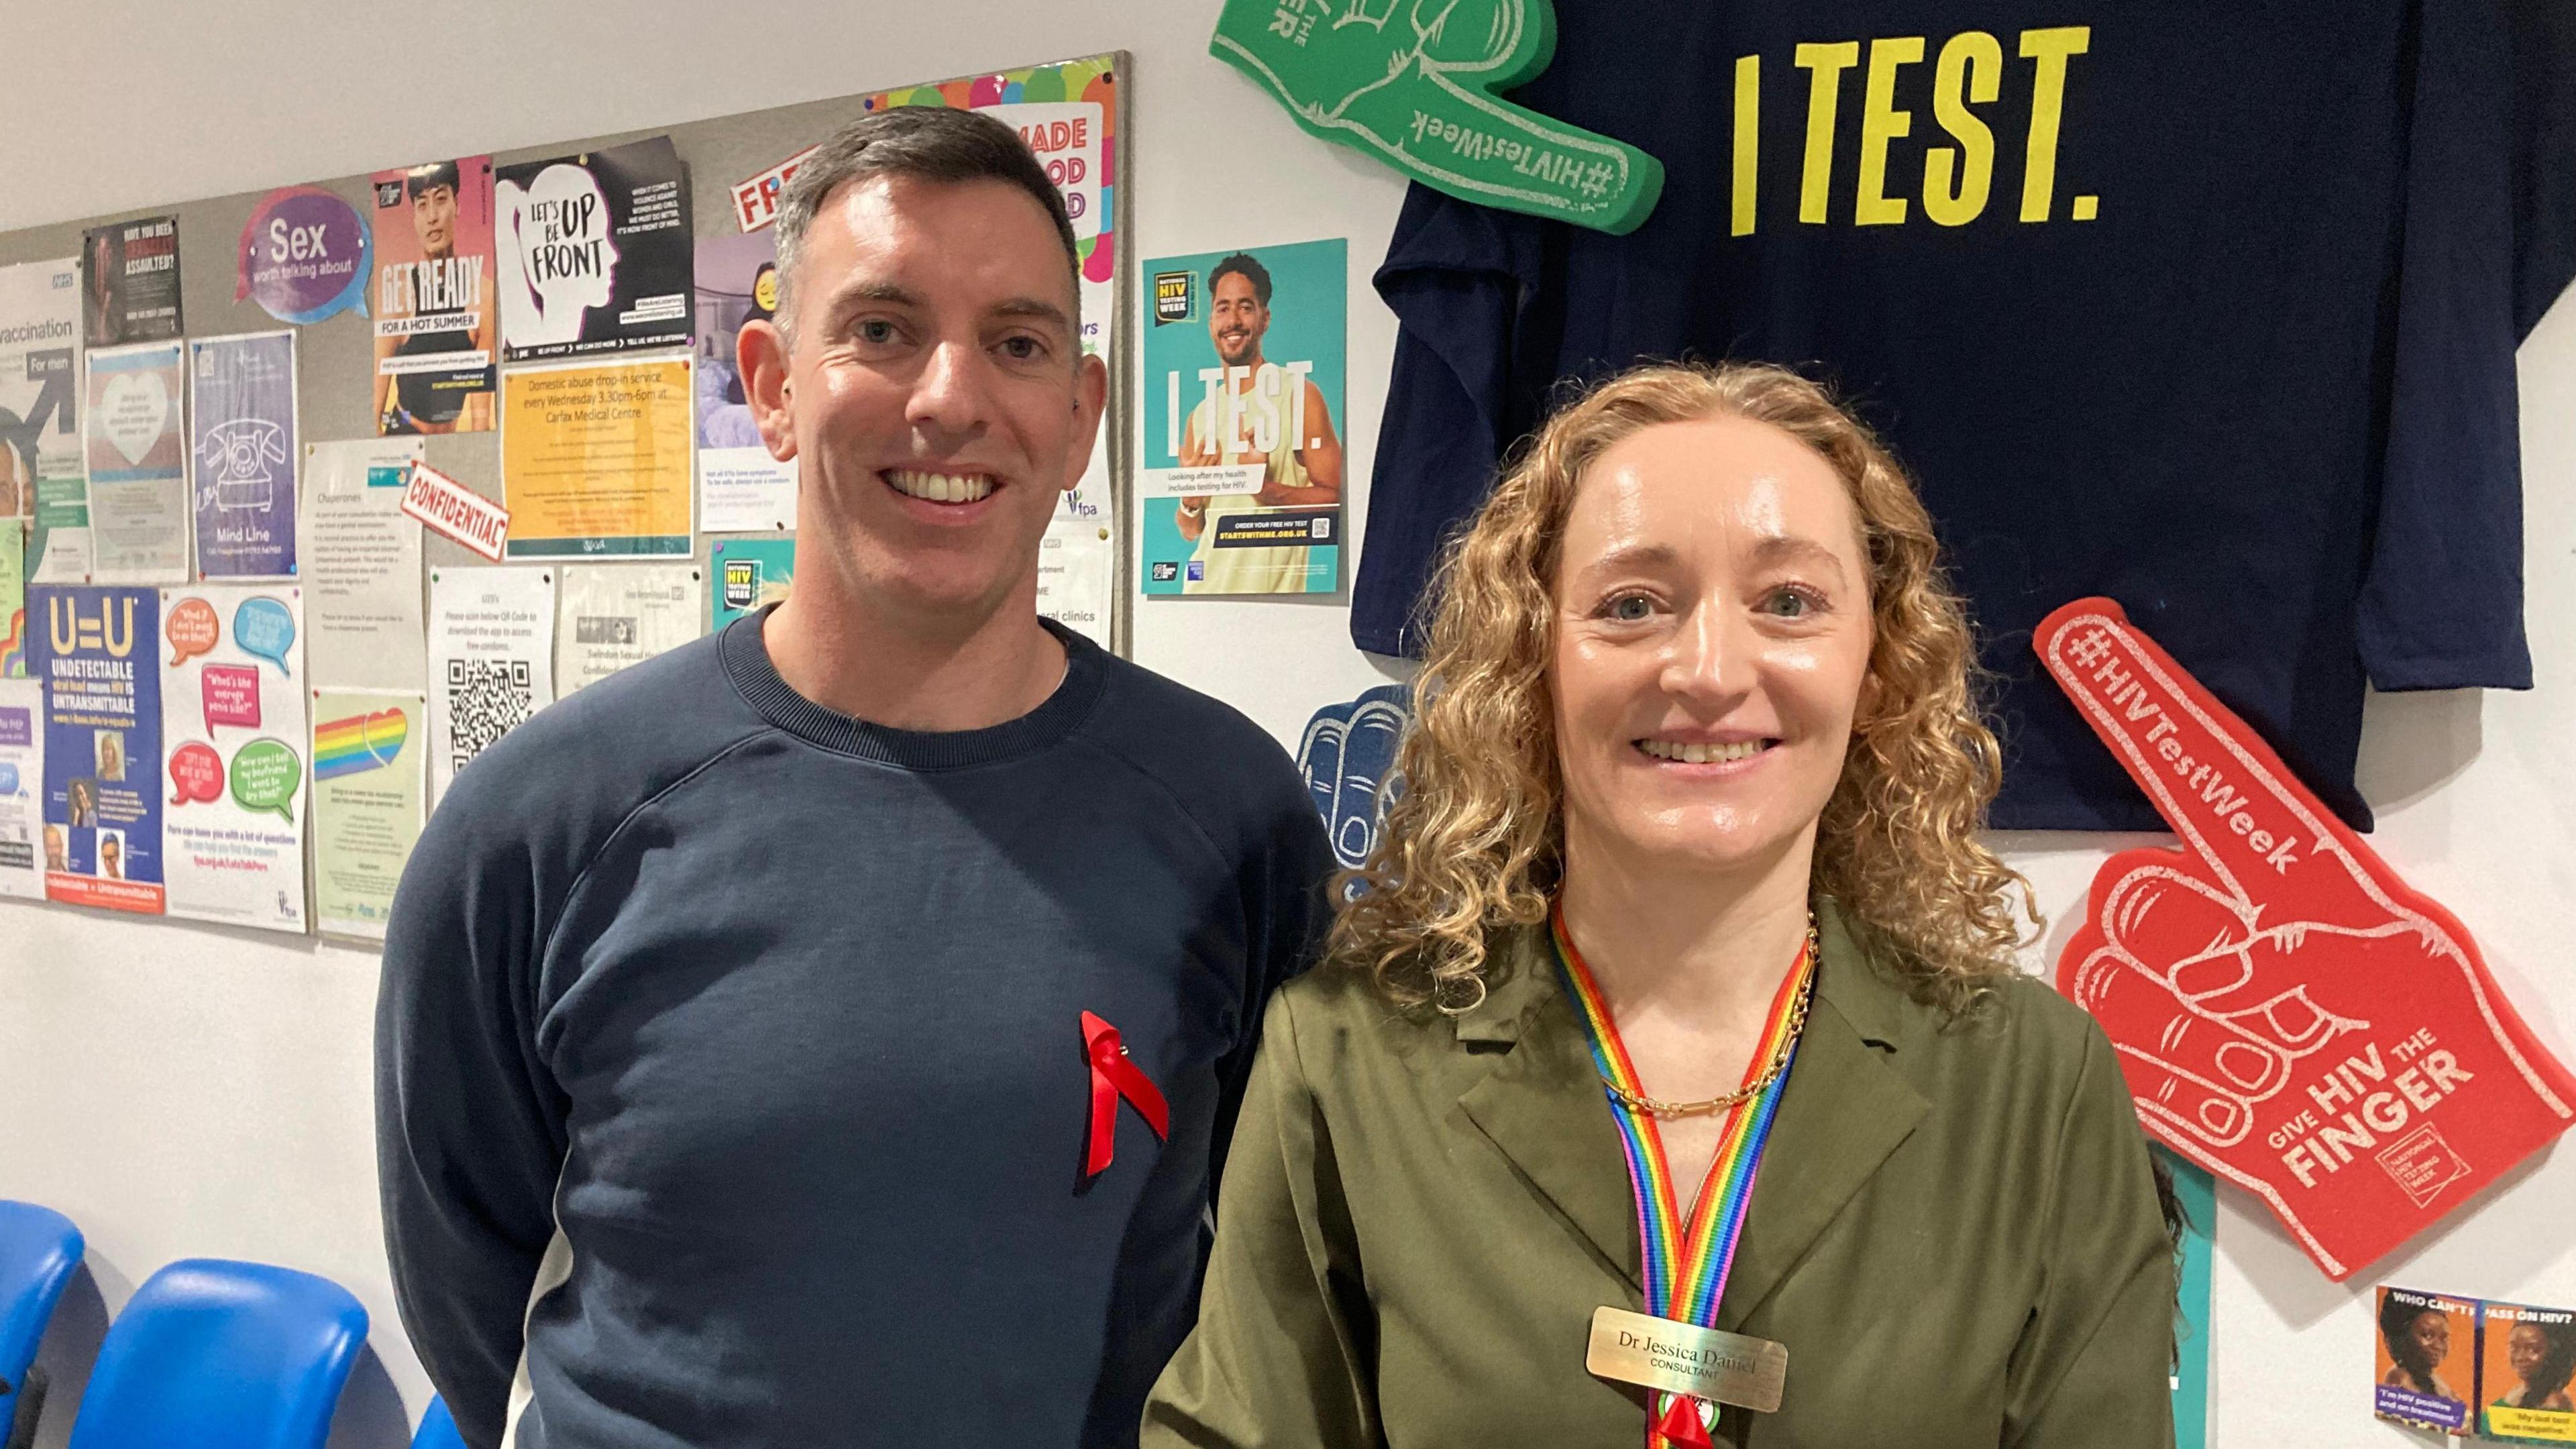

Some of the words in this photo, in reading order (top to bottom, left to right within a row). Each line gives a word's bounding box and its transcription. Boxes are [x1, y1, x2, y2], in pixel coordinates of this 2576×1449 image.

[1294, 15, 1317, 47] THE
[1731, 54, 1760, 237] I
[1794, 25, 2099, 227] TEST.
[1410, 109, 1615, 200] #HIVTestWeek
[531, 200, 559, 223] LET'S
[562, 193, 596, 238] UP
[270, 218, 327, 263] Sex
[545, 223, 559, 244] BE
[319, 258, 352, 275] about
[532, 239, 604, 284] FRONT
[382, 262, 415, 315] GET
[419, 255, 484, 311] READY
[1159, 282, 1187, 298] HIV
[1159, 303, 1186, 313] WEEK
[382, 321, 399, 334] FOR
[402, 320, 408, 331] A
[411, 318, 432, 330] HOT
[433, 314, 475, 329] SUMMER
[31, 358, 45, 372] For
[529, 379, 566, 392] Domestic
[568, 376, 594, 388] abuse
[595, 373, 629, 388] drop-in
[630, 371, 661, 384] service
[524, 396, 545, 409] every
[547, 392, 596, 407] Wednesday
[598, 389, 656, 405] 3.30pm-6pm
[657, 389, 667, 400] at
[1168, 370, 1179, 458] I
[1198, 360, 1321, 455] TEST.
[546, 409, 573, 424] Carfax
[574, 408, 609, 421] Medical
[611, 407, 641, 420] Centre
[1168, 472, 1195, 481] Looking
[1196, 472, 1212, 480] after
[1213, 472, 1223, 480] my
[1225, 470, 1247, 478] health
[1168, 482, 1195, 492] includes
[1197, 483, 1220, 492] testing
[409, 476, 501, 549] CONFIDENTIAL
[1077, 502, 1097, 517] fpa
[1284, 520, 1293, 528] HIV
[1294, 519, 1308, 527] TEST
[217, 526, 243, 543] Mind
[246, 527, 270, 542] Line
[1219, 529, 1307, 540] STARTSWITHME.ORG.UK
[727, 570, 751, 584] HIV
[727, 590, 751, 599] WEEK
[511, 610, 528, 621] Code
[1062, 610, 1095, 622] clinics
[49, 595, 133, 658] U=U
[587, 649, 619, 659] Swindon
[620, 650, 643, 660] Sexual
[52, 658, 133, 680] UNDETECTABLE
[52, 693, 136, 714] UNTRANSMITTABLE
[2068, 628, 2299, 875] #HIVTestWeek
[2268, 1109, 2319, 1149] GIVE
[2306, 1042, 2387, 1116] HIV
[2390, 1027, 2437, 1063] THE
[2281, 1049, 2475, 1189] FINGER
[2392, 1291, 2426, 1307] WHO
[2428, 1297, 2469, 1316] CAN'T
[2516, 1310, 2539, 1322] ON
[2540, 1312, 2573, 1324] HIV?
[1617, 1330, 1640, 1349] Dr
[1643, 1336, 1698, 1362] Jessica
[1703, 1349, 1757, 1375] Daniel
[1650, 1357, 1719, 1380] CONSULTANT
